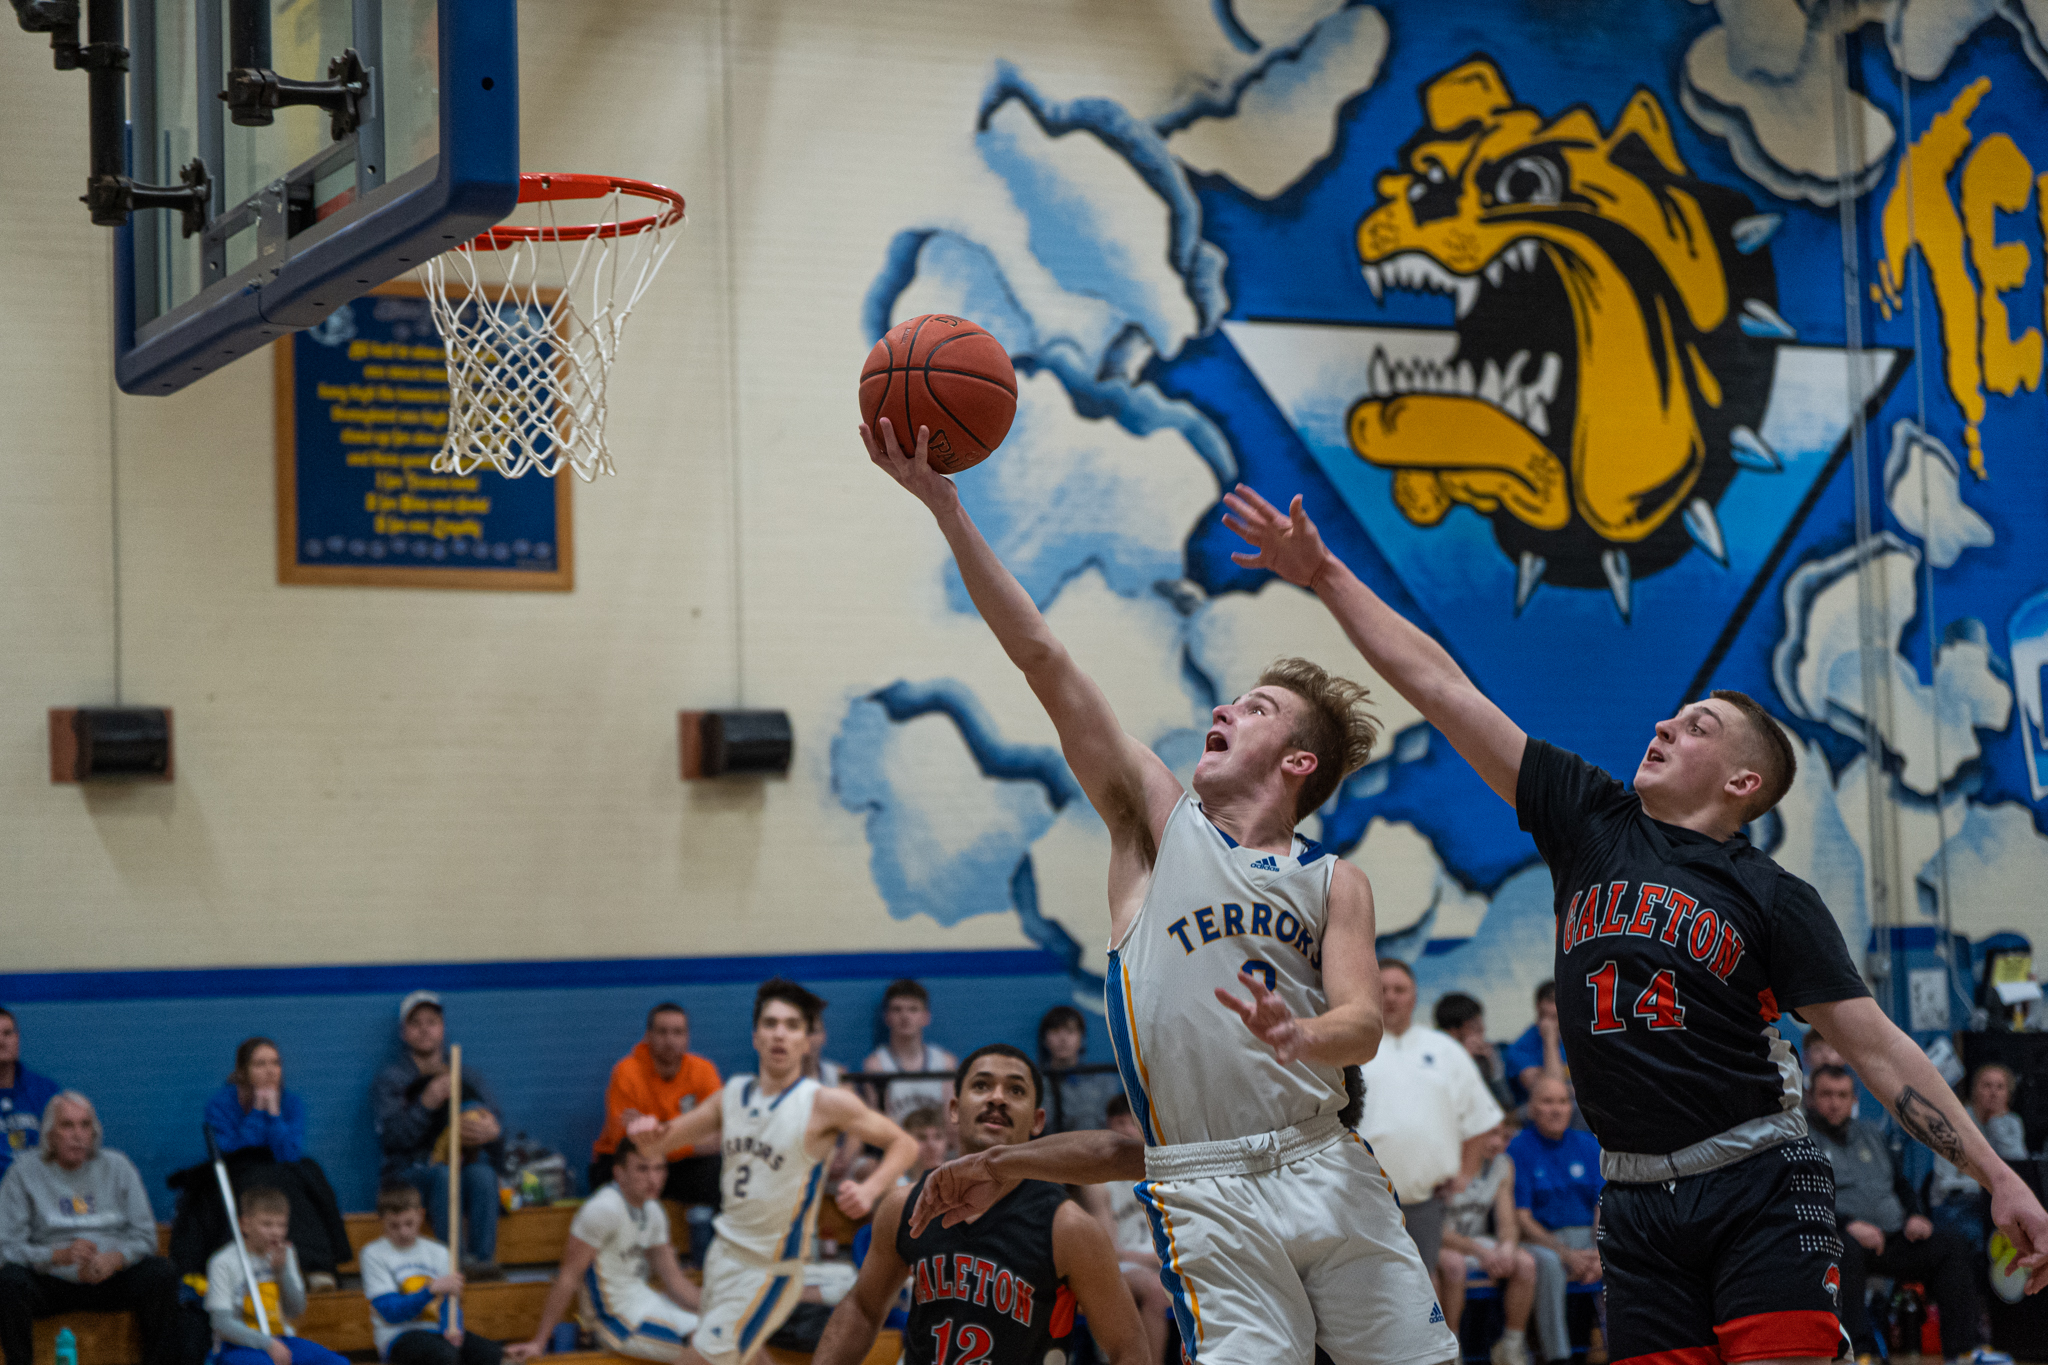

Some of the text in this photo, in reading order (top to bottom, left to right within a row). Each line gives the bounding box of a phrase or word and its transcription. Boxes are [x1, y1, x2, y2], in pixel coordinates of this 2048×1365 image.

[1563, 880, 1746, 986] GALETON
[1585, 960, 1687, 1035] 14
[733, 1163, 752, 1199] 2
[914, 1252, 1036, 1328] ALETON
[930, 1317, 994, 1365] 12
